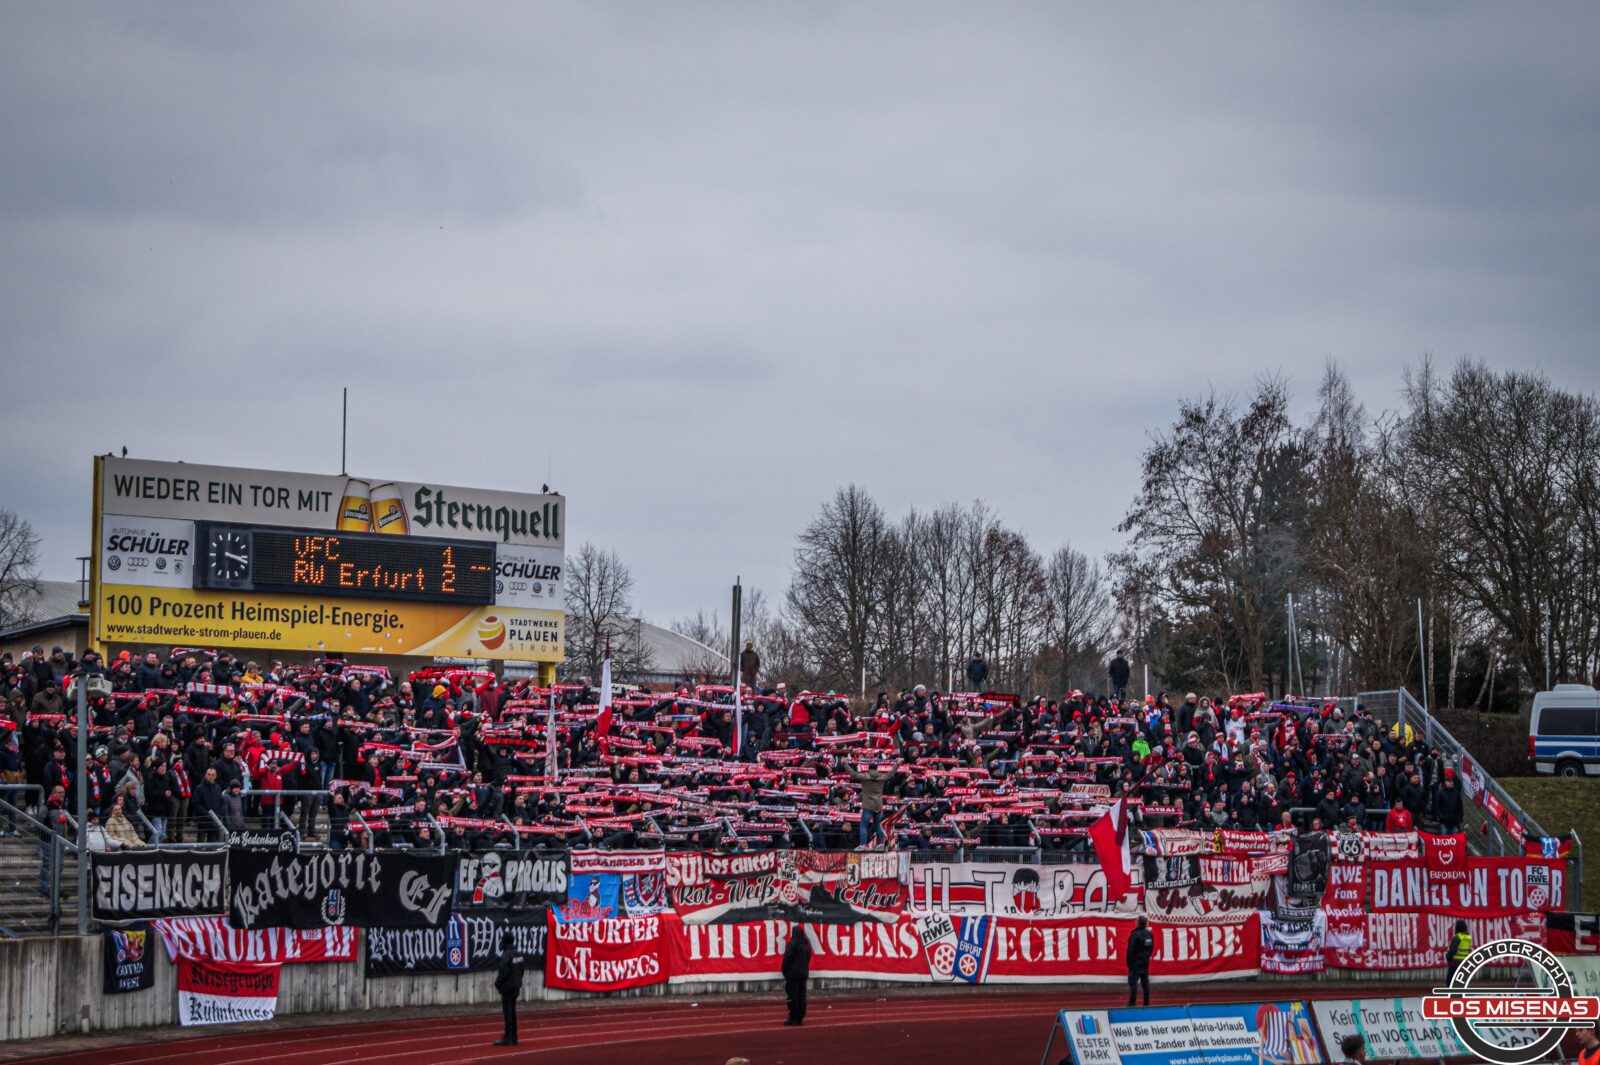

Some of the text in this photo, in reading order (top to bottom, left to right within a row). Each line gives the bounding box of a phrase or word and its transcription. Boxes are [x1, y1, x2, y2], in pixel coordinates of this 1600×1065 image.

[114, 474, 332, 513] WIEDER EIN TOR MIT
[413, 486, 561, 543] Sternquell
[112, 527, 147, 535] AUTOHAUS
[106, 532, 190, 556] SCHÜLER
[294, 560, 425, 590] RW Erfurt
[496, 559, 561, 580] SCHÜLER
[107, 595, 404, 633] 100 Prozent Heimspiel-Energie.
[107, 623, 282, 641] www.stadtwerke-strom-plauen.de
[510, 619, 558, 628] STADTWERKE
[510, 629, 558, 642] PLAUEN
[509, 644, 558, 652] STROM
[241, 831, 279, 846] Gedenken
[1343, 839, 1360, 854] 66
[1432, 838, 1457, 846] LEGIO
[703, 858, 729, 875] LOS
[731, 851, 776, 874] CHICOS
[1531, 866, 1544, 875] FC
[459, 858, 480, 891] EF
[1331, 865, 1363, 885] RWE
[1527, 875, 1549, 884] RWE
[95, 862, 221, 911] EISENACH
[924, 912, 942, 926] FC
[555, 917, 660, 944] ERFURTER
[921, 918, 953, 945] RWE
[1368, 912, 1419, 950] ERFURT
[959, 940, 983, 957] ERFURT
[996, 926, 1118, 962] ECHTE
[555, 946, 660, 983] UNTERWEGS
[1329, 1009, 1359, 1026] Kein
[1360, 1008, 1381, 1024] Tor
[1383, 1007, 1414, 1023] mehr
[1113, 1021, 1245, 1038] Weil Sie hier vom Adria-Urlaub
[1366, 1030, 1382, 1044] im
[1382, 1026, 1443, 1043] VOGTLAND
[1077, 1037, 1111, 1049] ELSTER
[1118, 1035, 1260, 1052] bis zum Zander alles bekommen.
[1084, 1049, 1112, 1060] PARK
